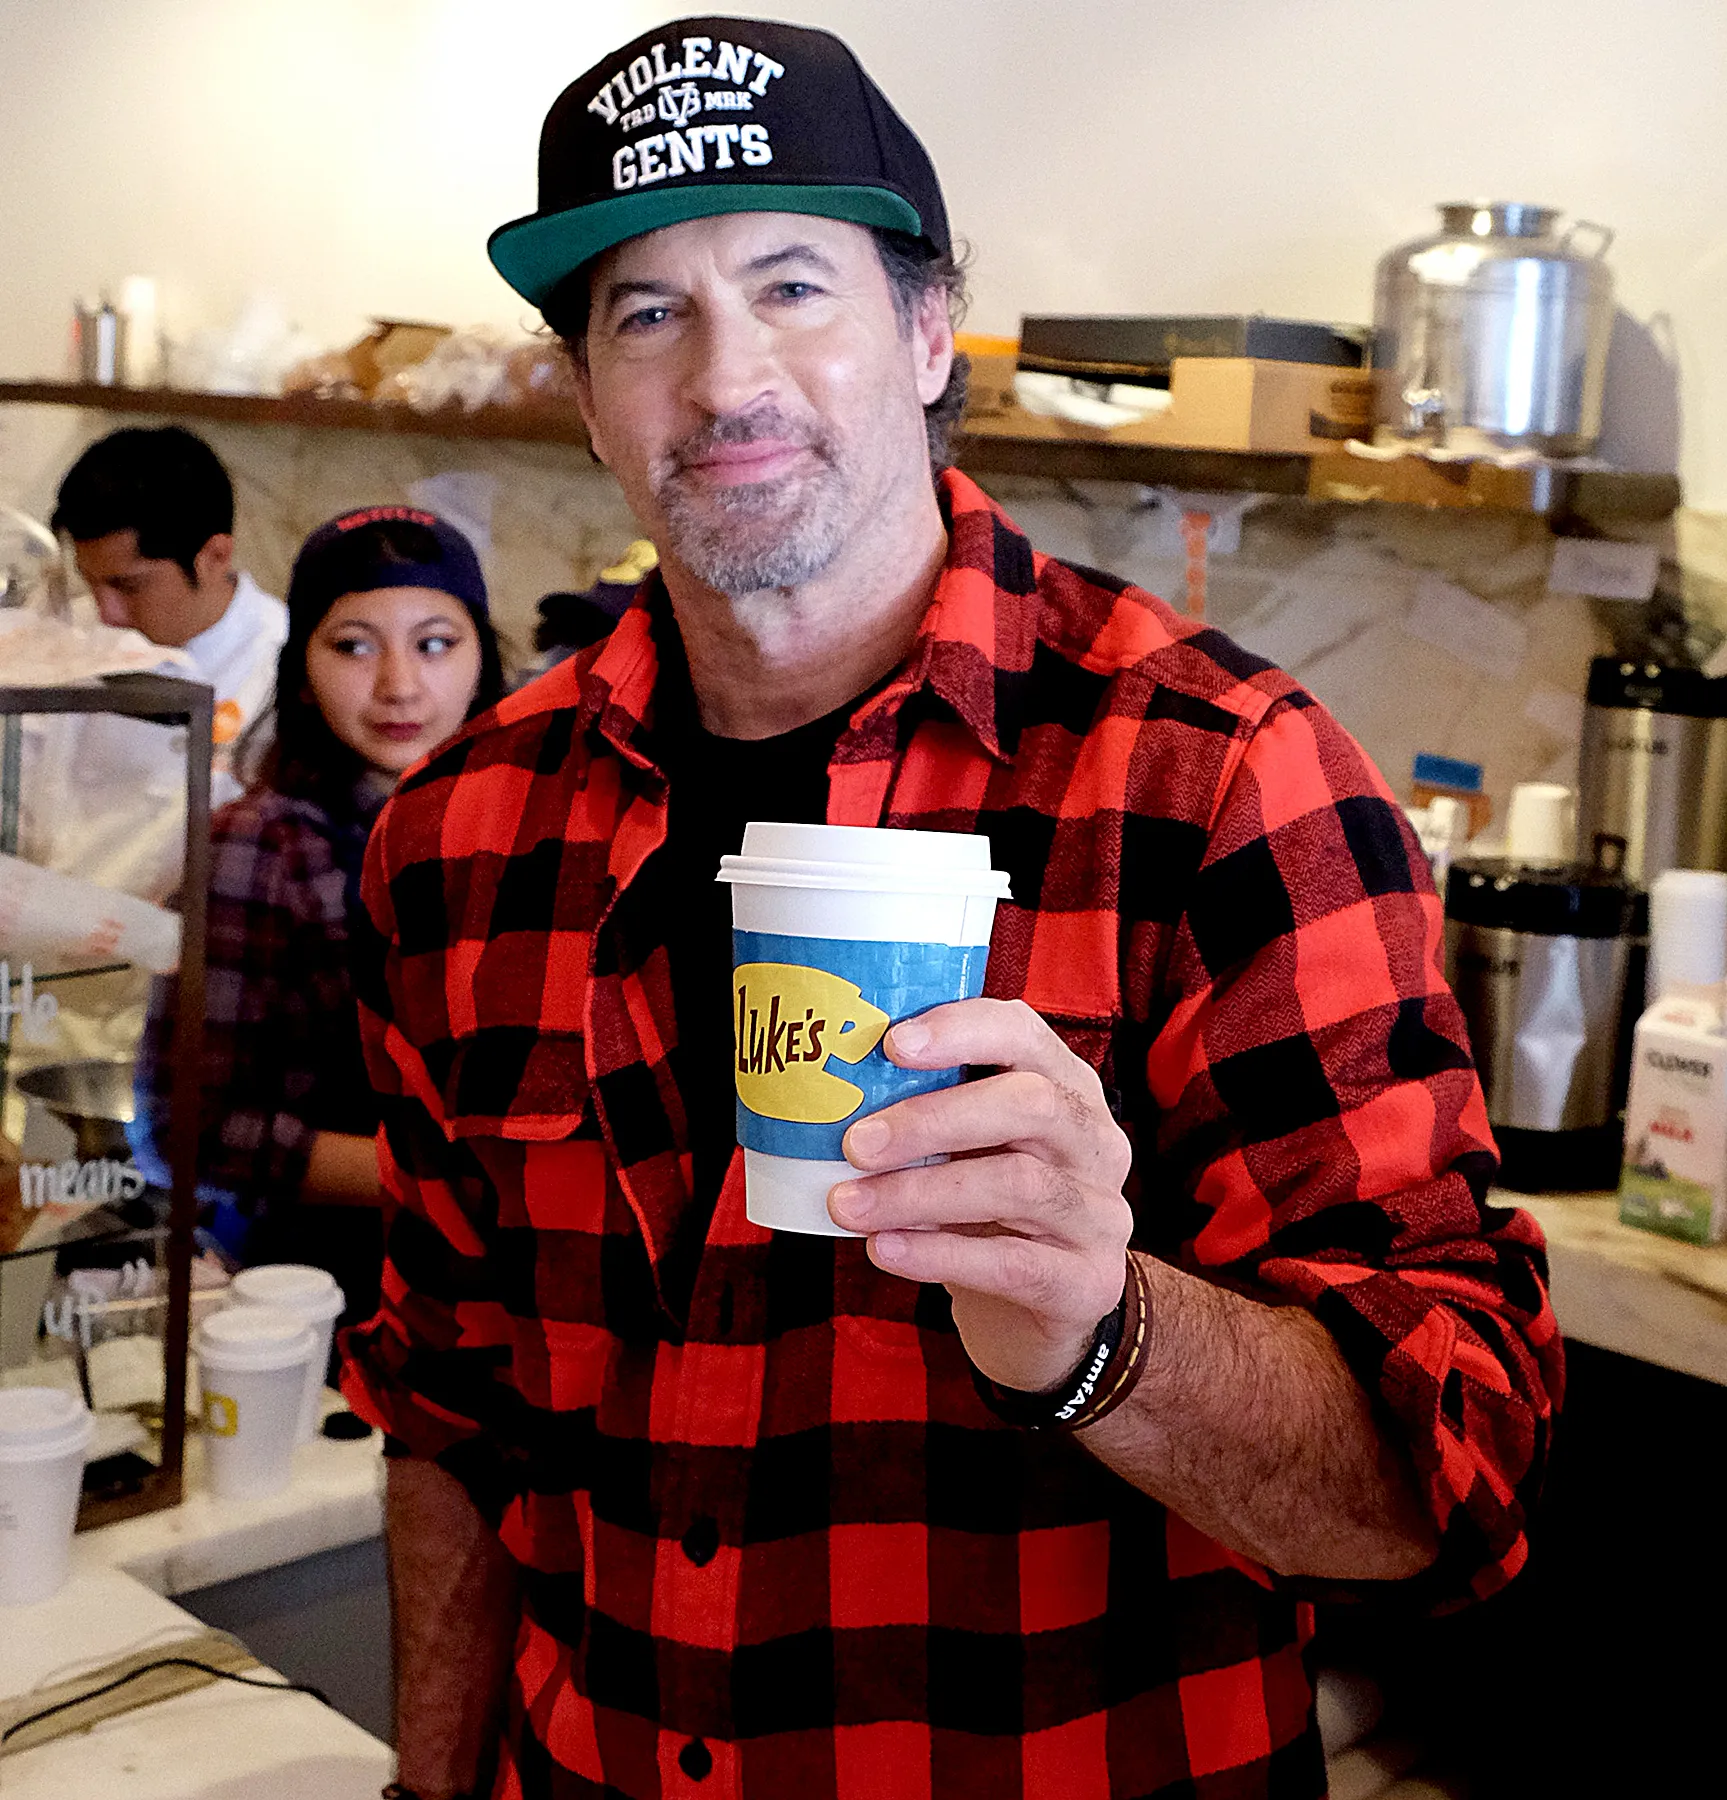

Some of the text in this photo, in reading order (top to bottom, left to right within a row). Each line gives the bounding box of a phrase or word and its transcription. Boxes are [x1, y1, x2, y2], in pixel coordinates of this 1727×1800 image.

[587, 37, 785, 126] VIOLENT
[620, 104, 656, 132] TRD
[703, 91, 755, 111] MRK
[612, 124, 773, 190] GENTS
[19, 1158, 146, 1208] means
